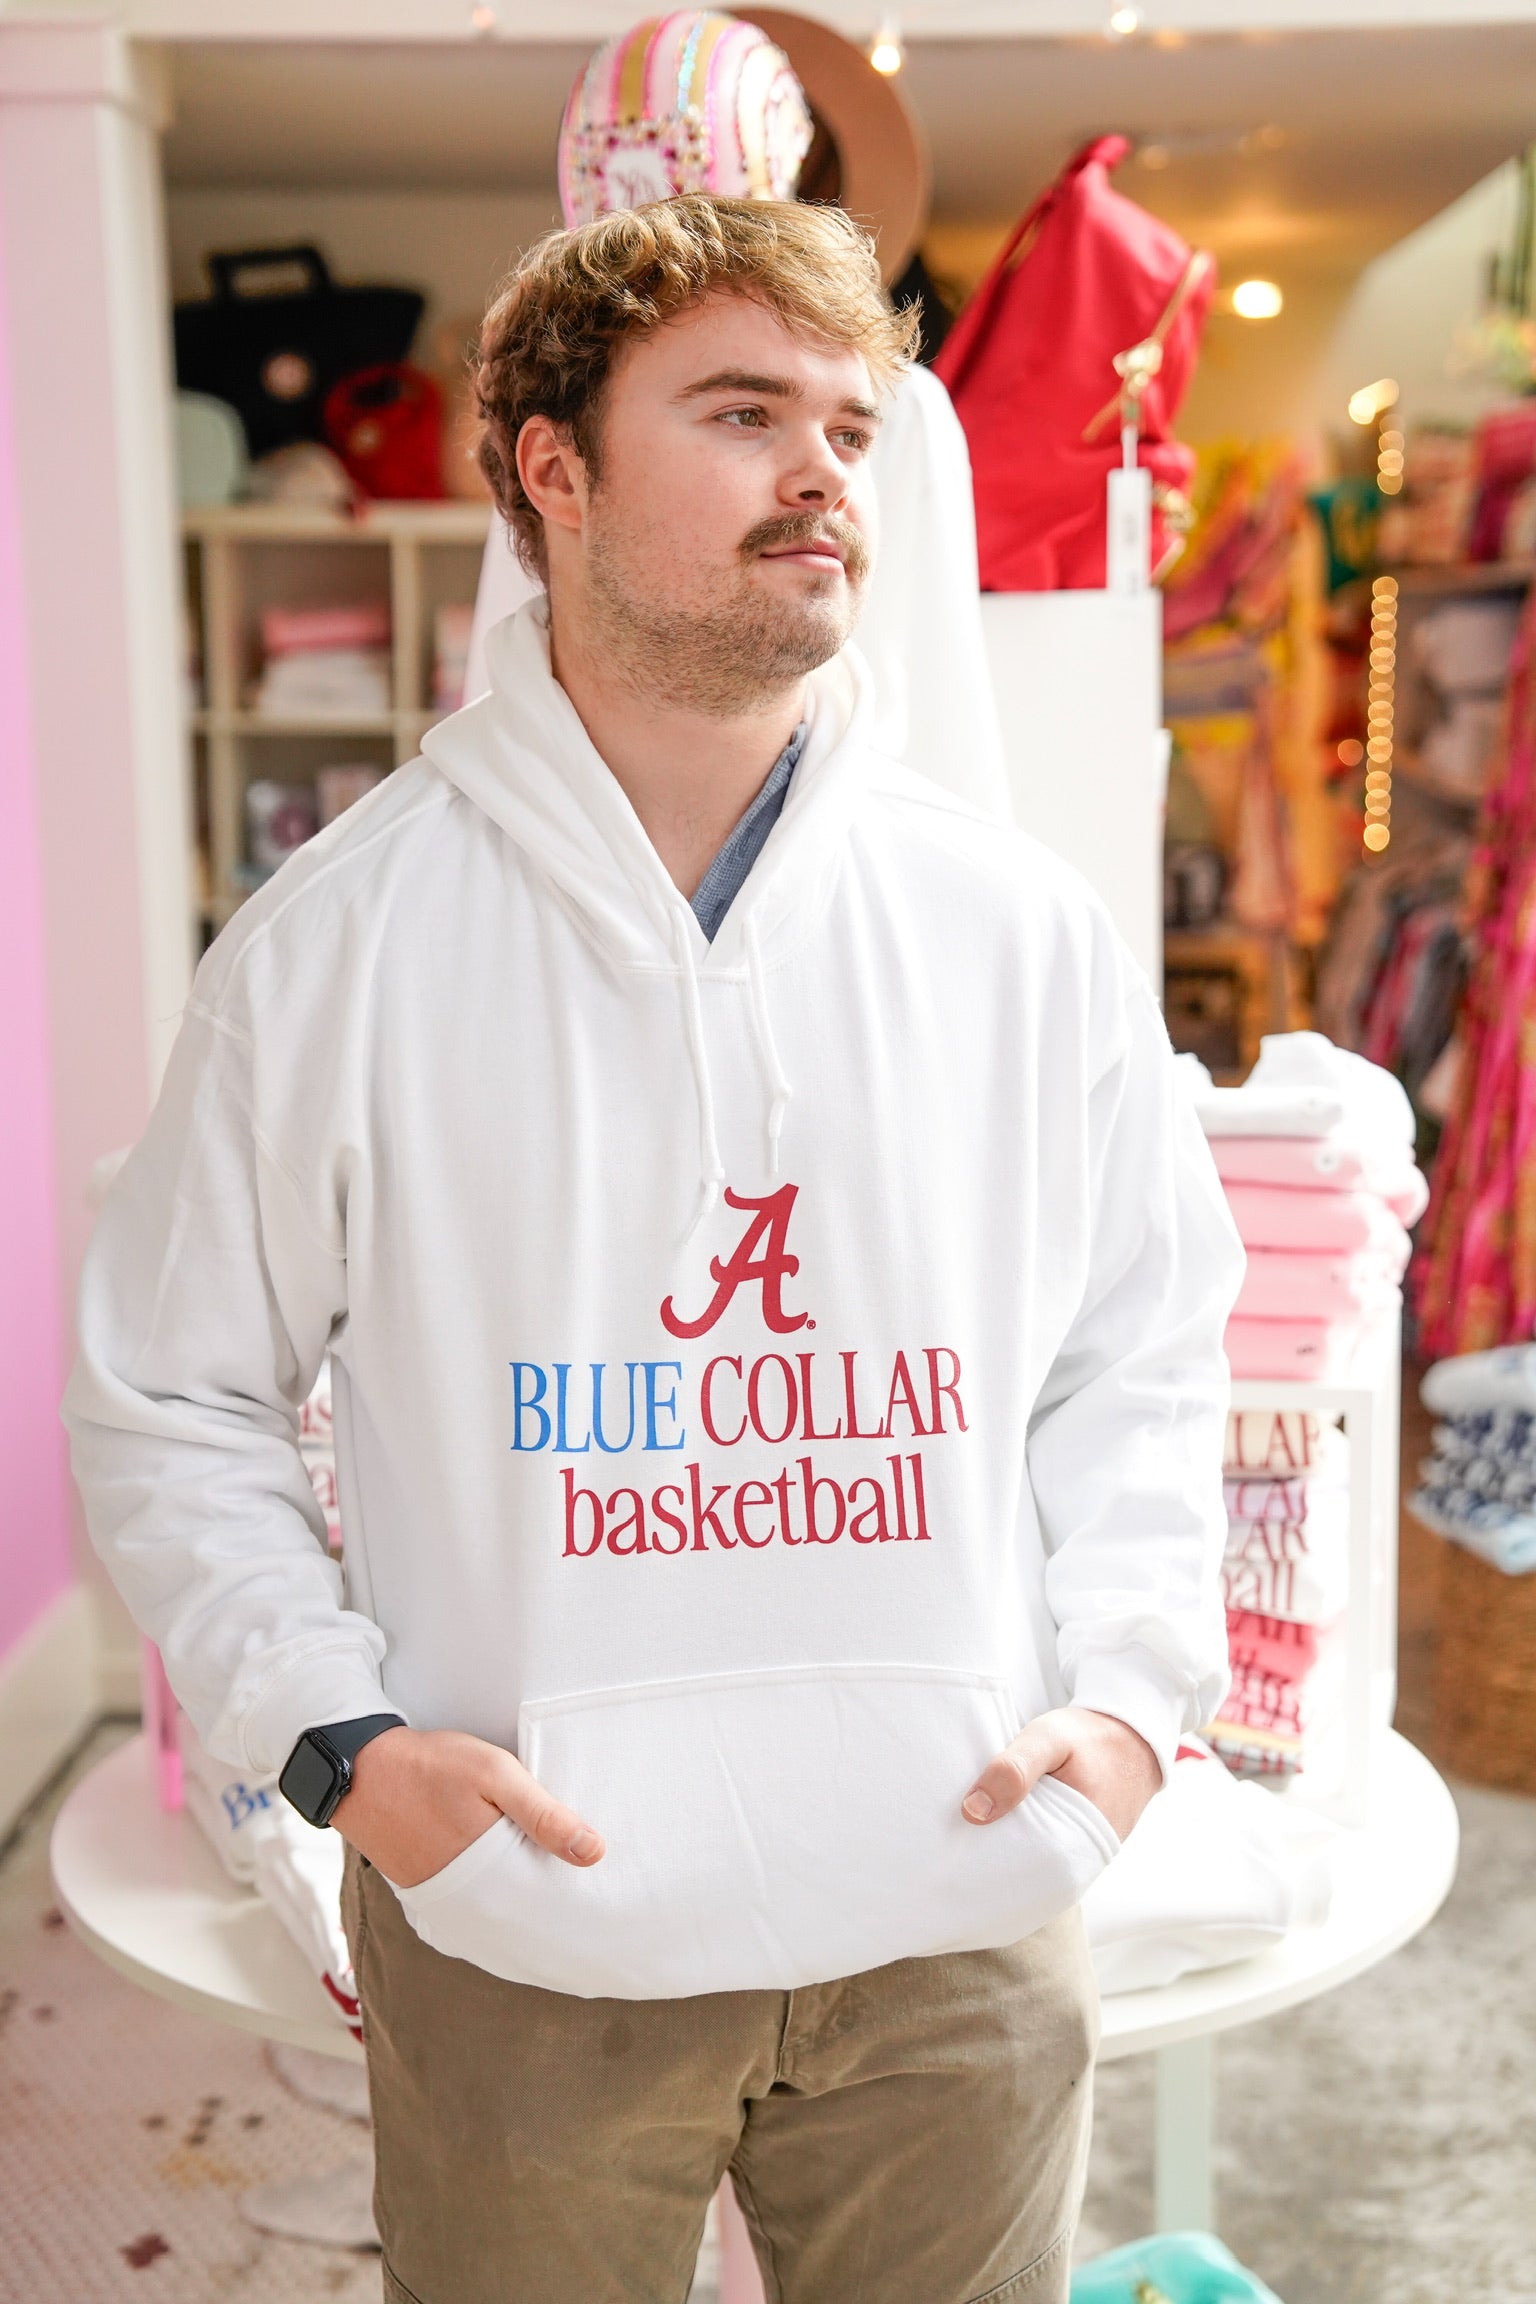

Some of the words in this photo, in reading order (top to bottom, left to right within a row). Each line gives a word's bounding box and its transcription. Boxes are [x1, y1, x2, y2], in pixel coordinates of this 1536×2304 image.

[509, 1361, 686, 1454] BLUE
[700, 1347, 969, 1447] COLLAR
[559, 1452, 932, 1558] basketball
